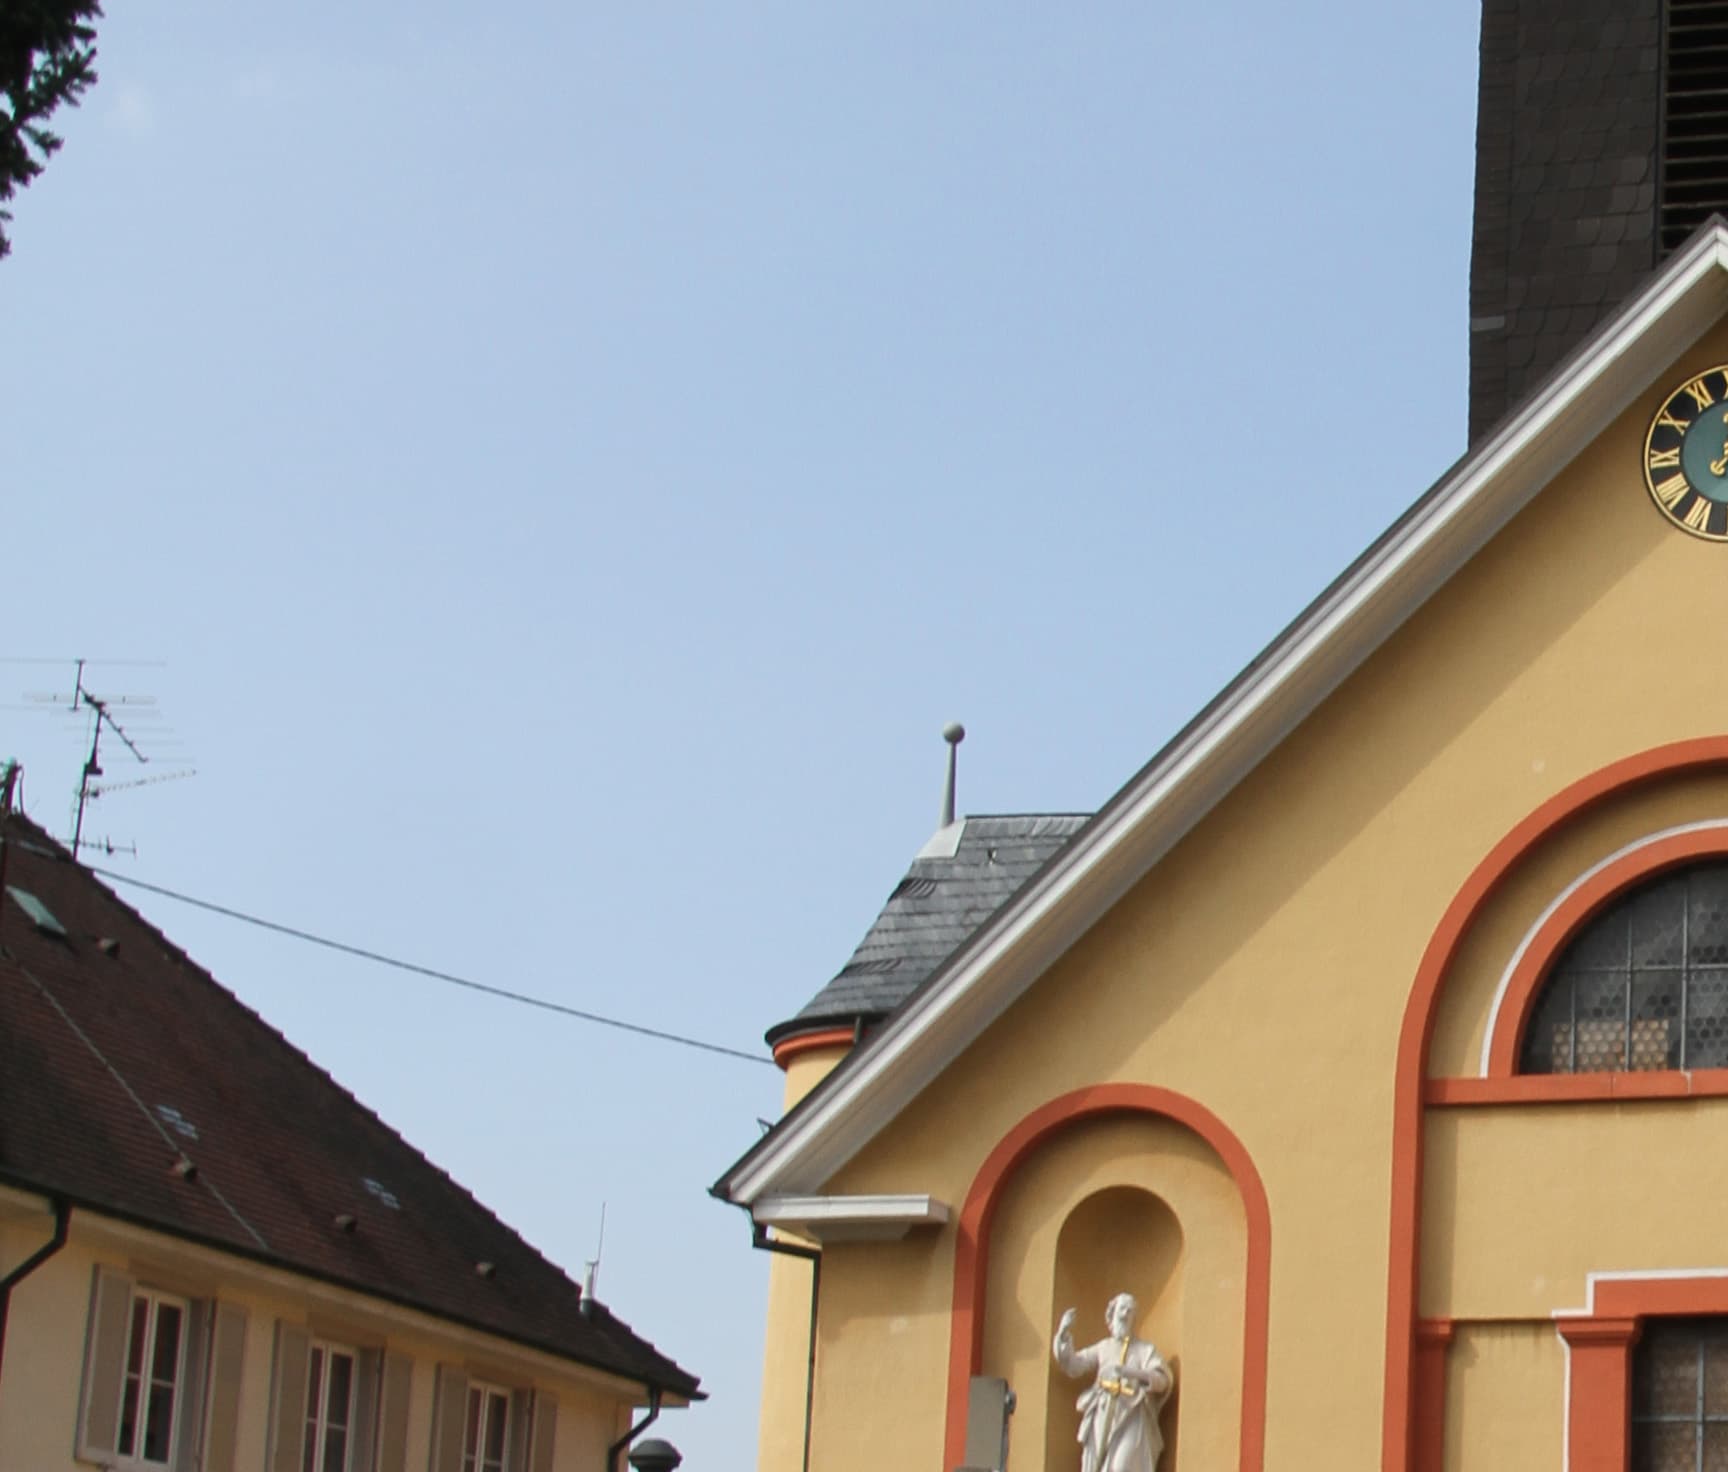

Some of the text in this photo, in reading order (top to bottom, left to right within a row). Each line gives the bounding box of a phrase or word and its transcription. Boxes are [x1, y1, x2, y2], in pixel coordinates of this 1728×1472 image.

[1685, 378, 1715, 412] XI
[1659, 411, 1690, 435] X
[1650, 448, 1680, 468] IX
[1655, 473, 1690, 510] VIII
[1684, 496, 1712, 532] VII
